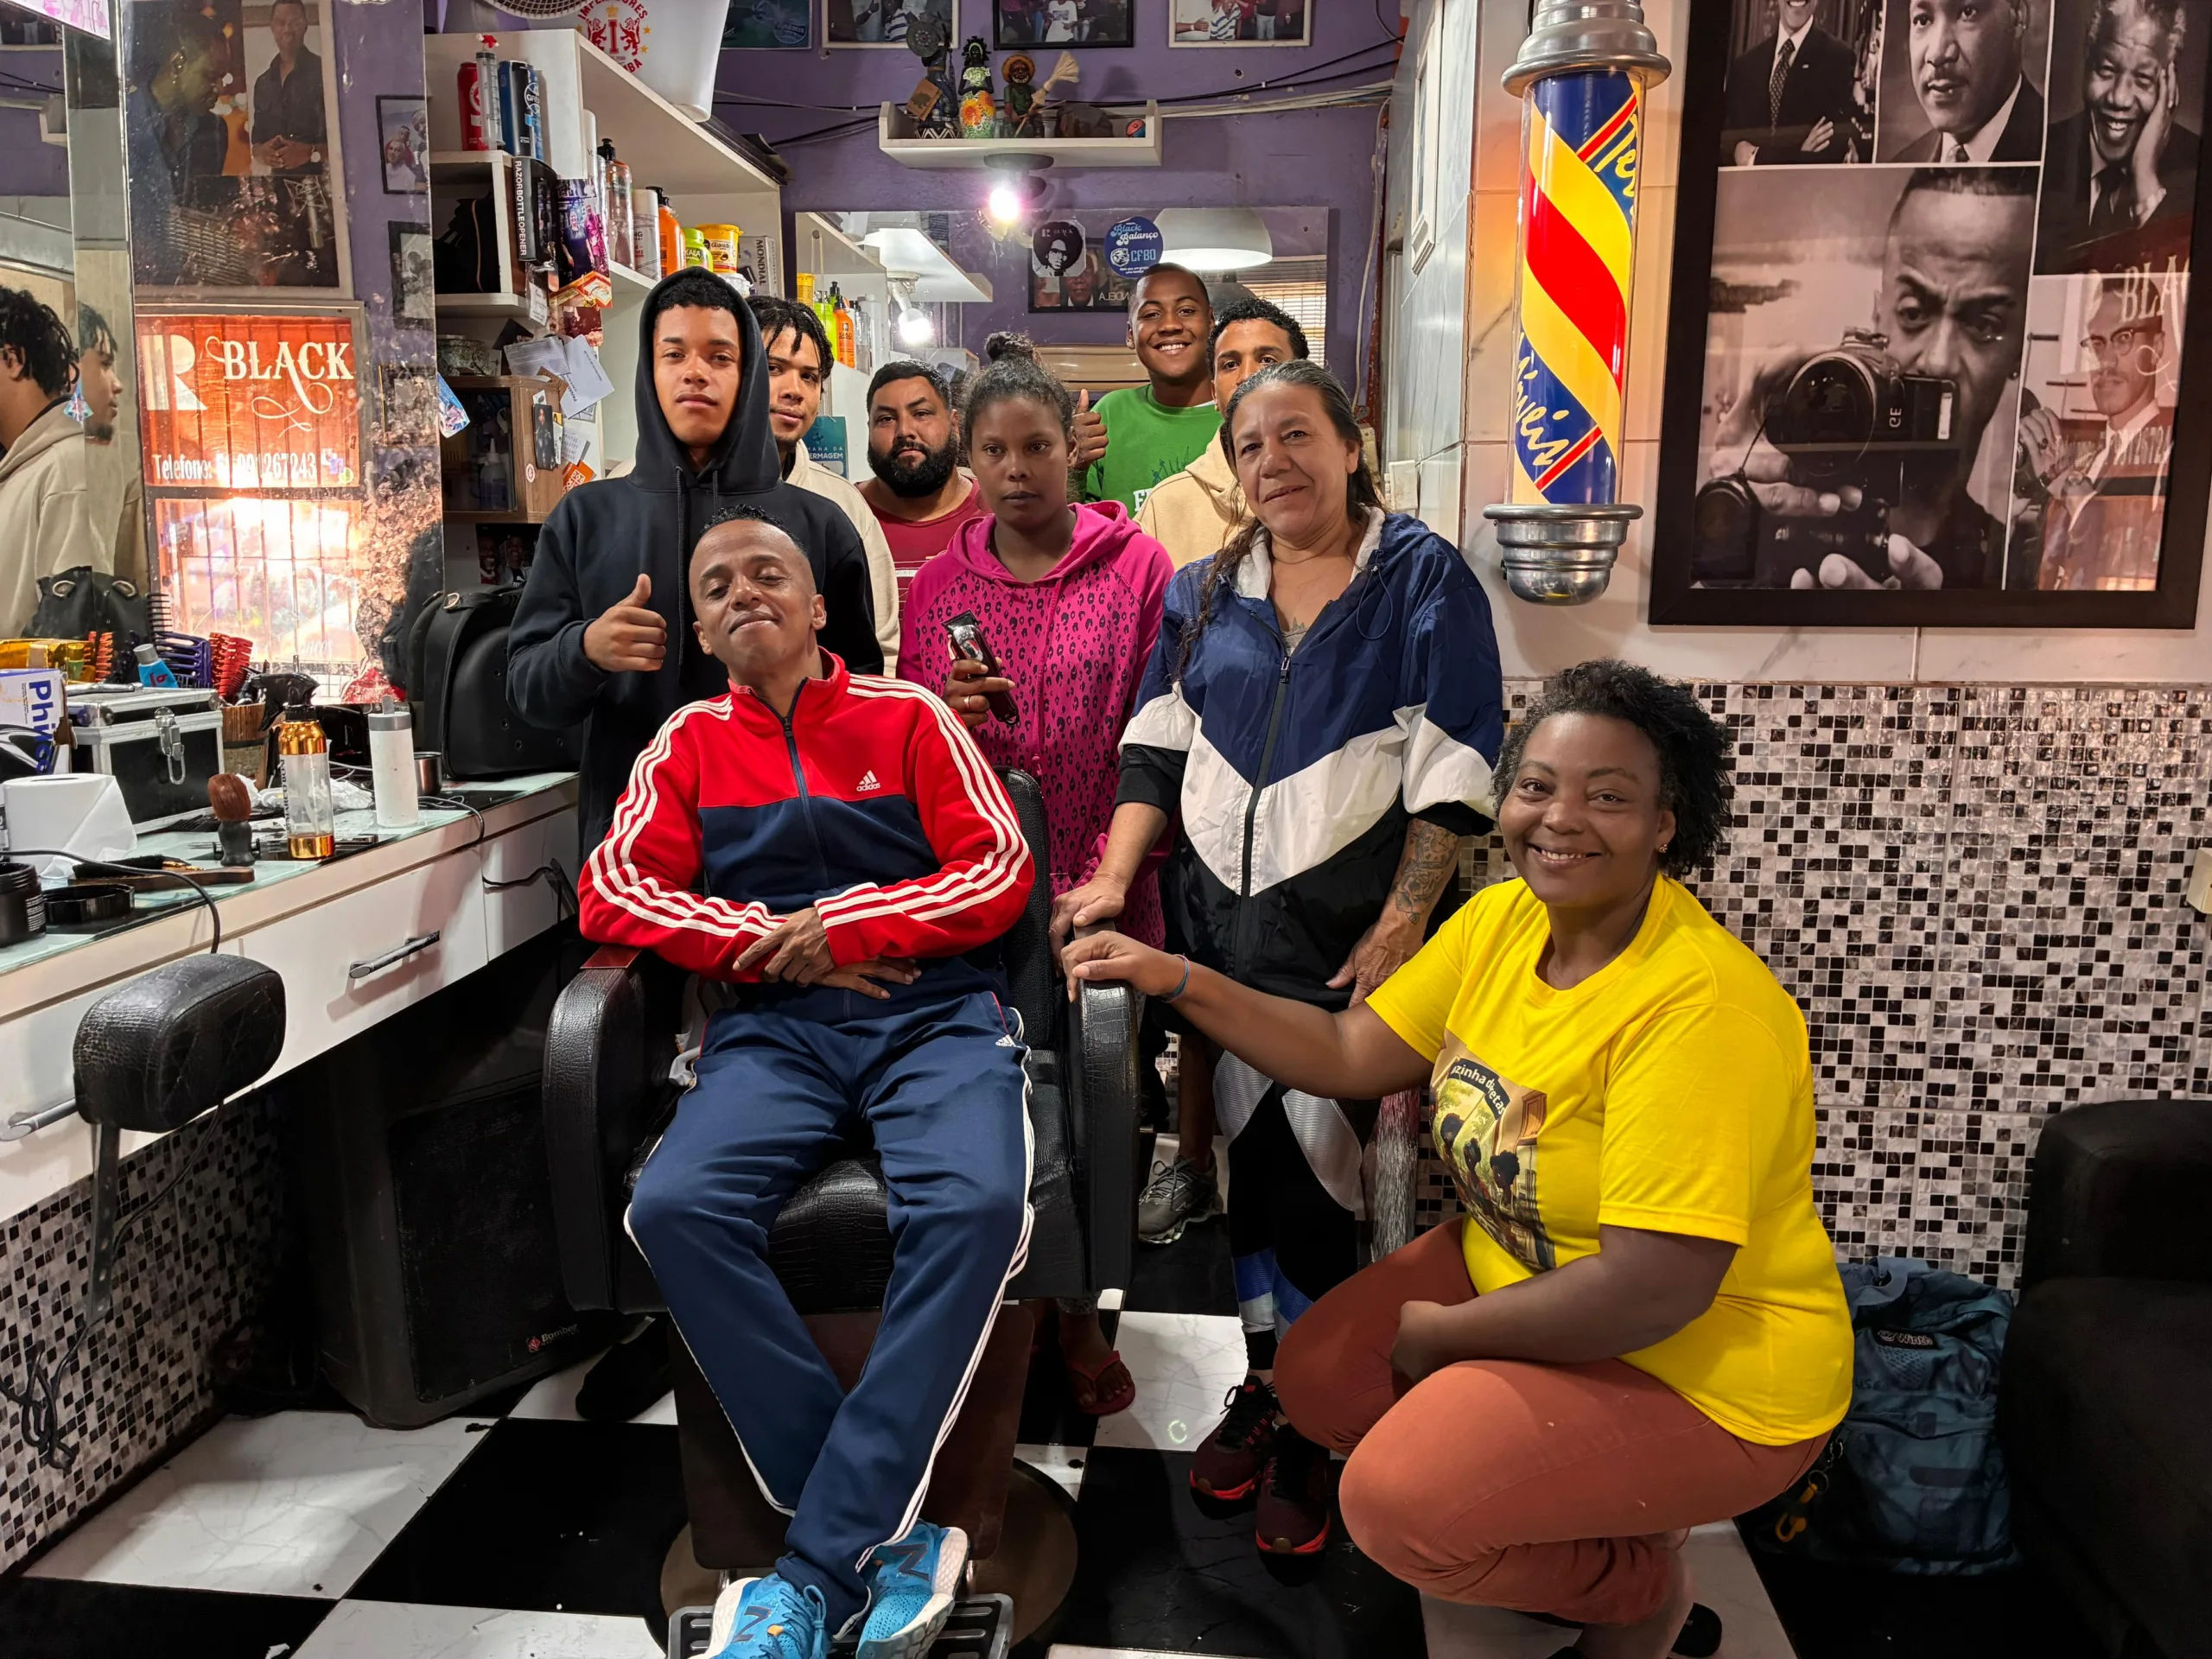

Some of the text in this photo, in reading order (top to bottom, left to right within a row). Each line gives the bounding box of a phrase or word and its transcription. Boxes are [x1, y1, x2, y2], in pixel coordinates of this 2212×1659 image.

[1110, 224, 1142, 237] Black
[756, 239, 766, 285] MONDIAL
[152, 454, 213, 480] Telefone:
[856, 782, 881, 792] adidas
